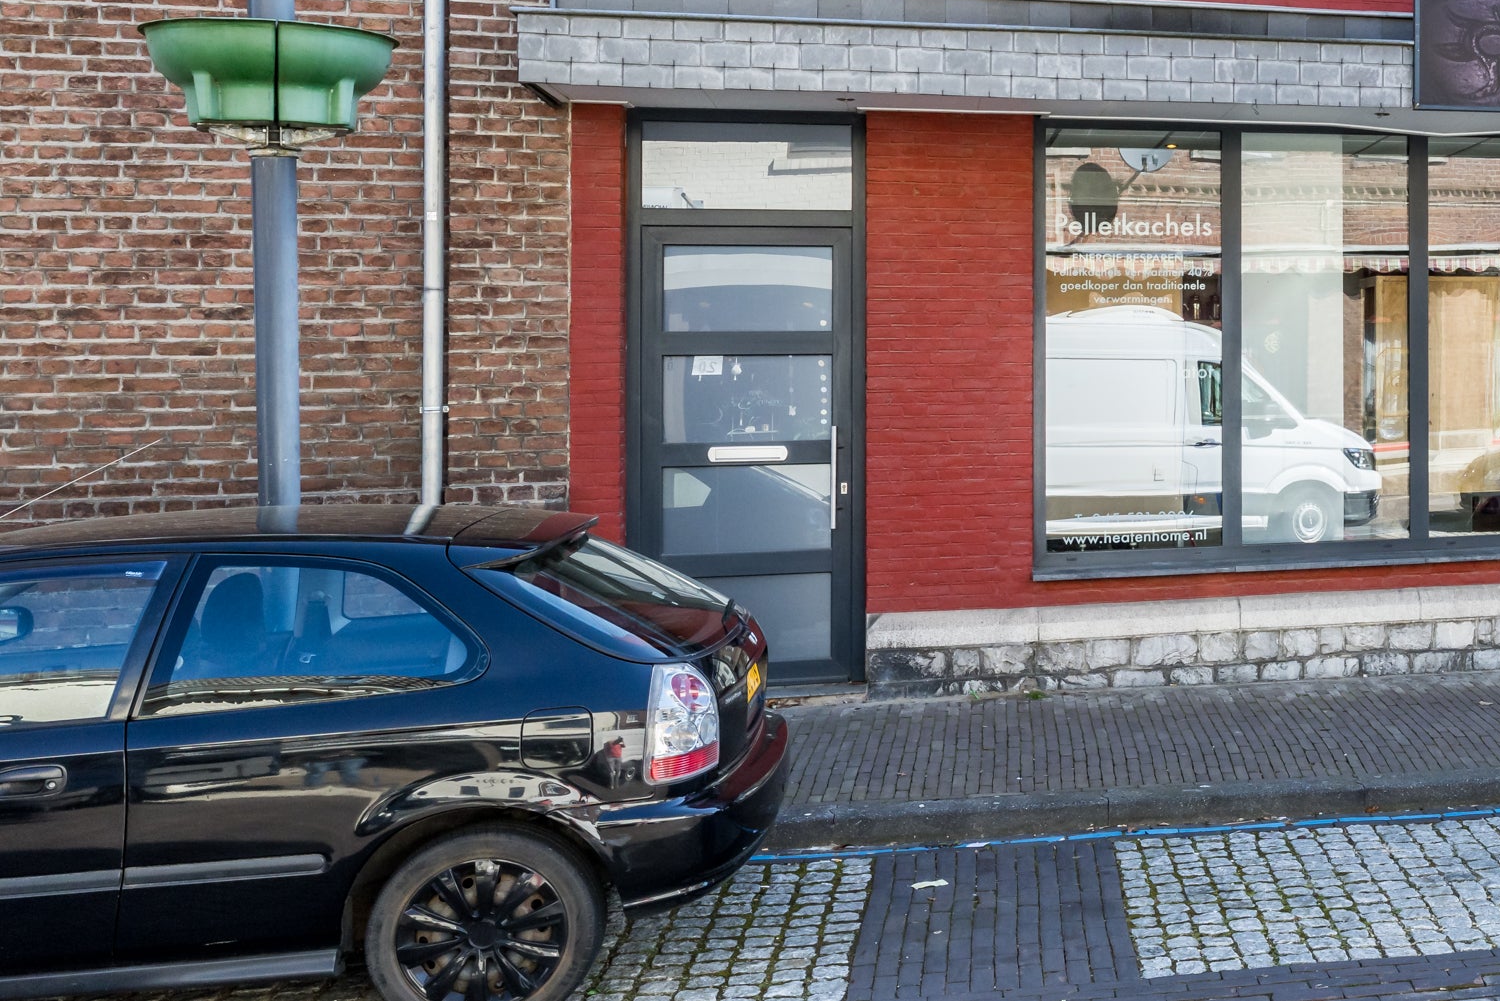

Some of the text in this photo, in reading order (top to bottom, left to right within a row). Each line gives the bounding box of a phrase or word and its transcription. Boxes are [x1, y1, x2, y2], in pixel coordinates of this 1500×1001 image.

[1055, 211, 1213, 237] Pelletkachels
[1072, 252, 1184, 263] ENERGIE BESPAREN
[1053, 267, 1122, 277] Pelletkachels
[1187, 267, 1213, 277] 40%
[1060, 280, 1206, 292] goedkoper dan traditionele
[1093, 295, 1173, 306] verwarmingen.
[1063, 529, 1207, 545] www.heatenhome.nl
